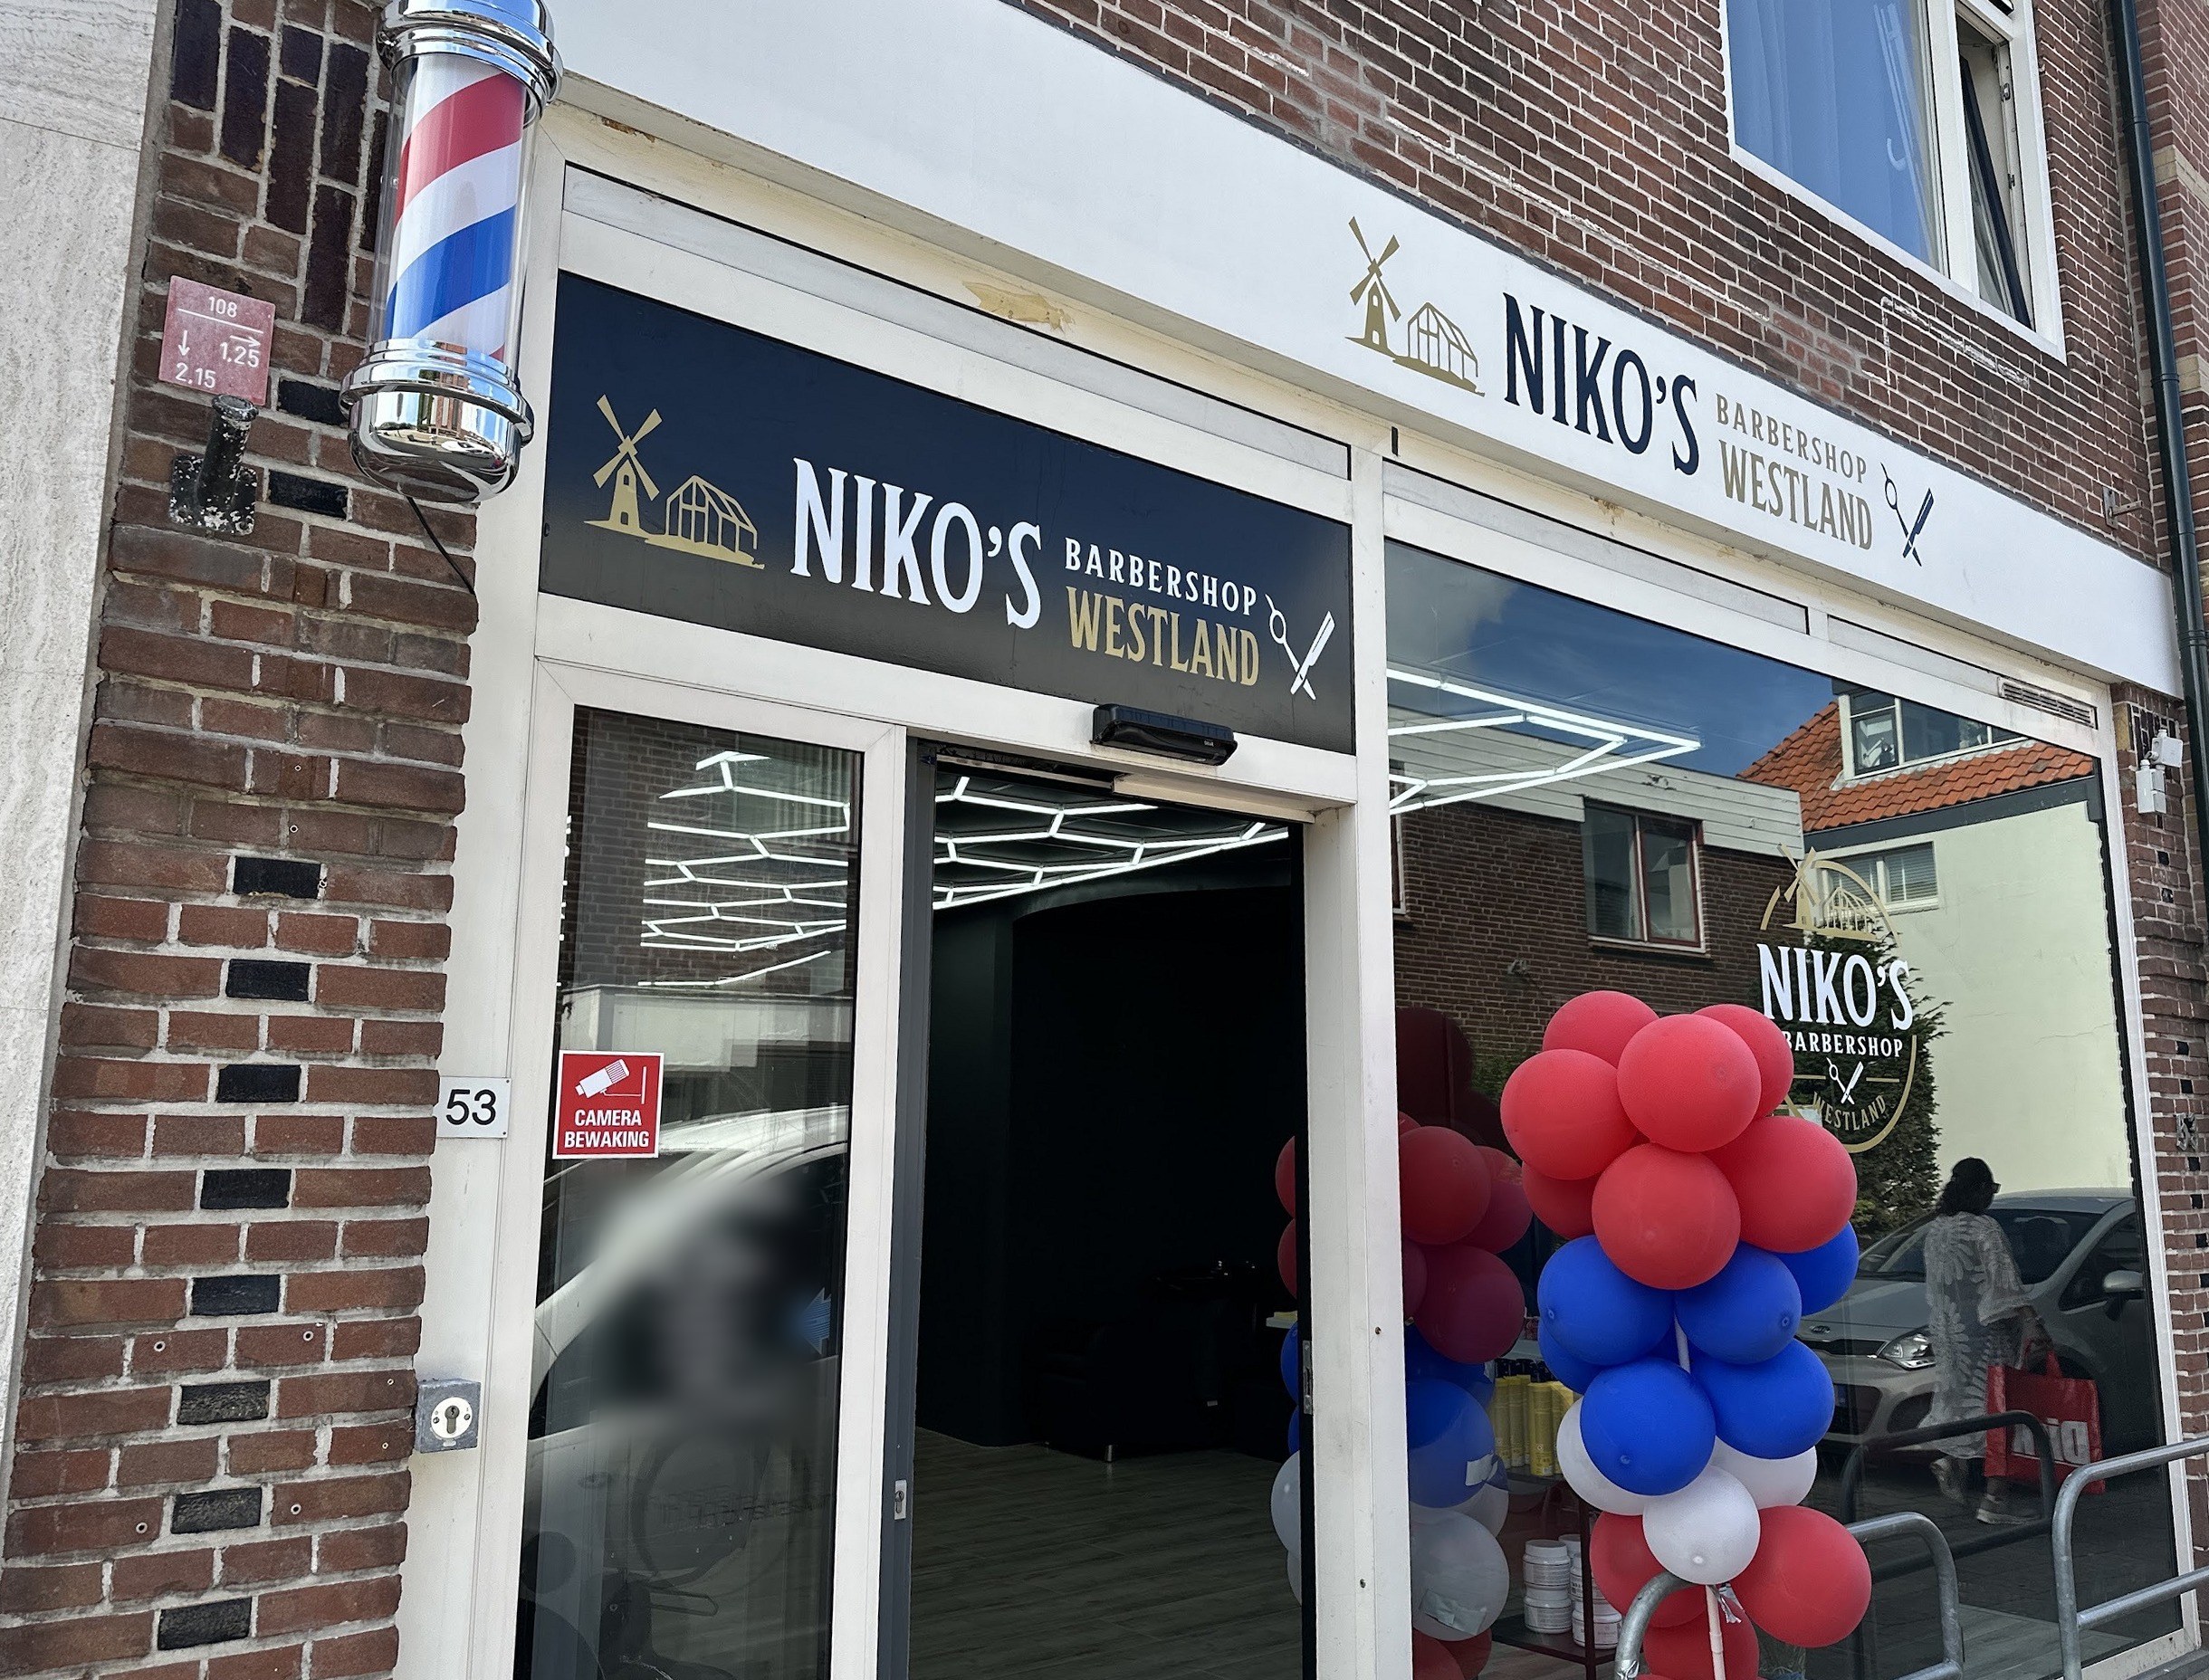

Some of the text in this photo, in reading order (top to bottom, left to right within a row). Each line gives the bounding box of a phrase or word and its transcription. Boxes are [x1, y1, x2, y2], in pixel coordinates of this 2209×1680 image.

[209, 296, 237, 318] 108
[220, 342, 260, 368] 1.25
[176, 363, 216, 388] 2.15
[1503, 291, 1699, 476] NIKO'S
[1716, 393, 1867, 483] BARBERSHOP
[1719, 440, 1872, 550] WESTLAND
[790, 457, 1041, 629] NIKO'S
[1065, 537, 1257, 616] BARBERSHOP
[1066, 586, 1260, 686] WESTLAND
[1756, 943, 1913, 1030] NIKO'S
[1783, 1030, 1903, 1057] BARBERSHOP
[445, 1089, 496, 1125] 53
[575, 1110, 642, 1126] CAMERA
[1812, 1092, 1887, 1131] WESTLAND
[564, 1131, 649, 1149] BEWAKING
